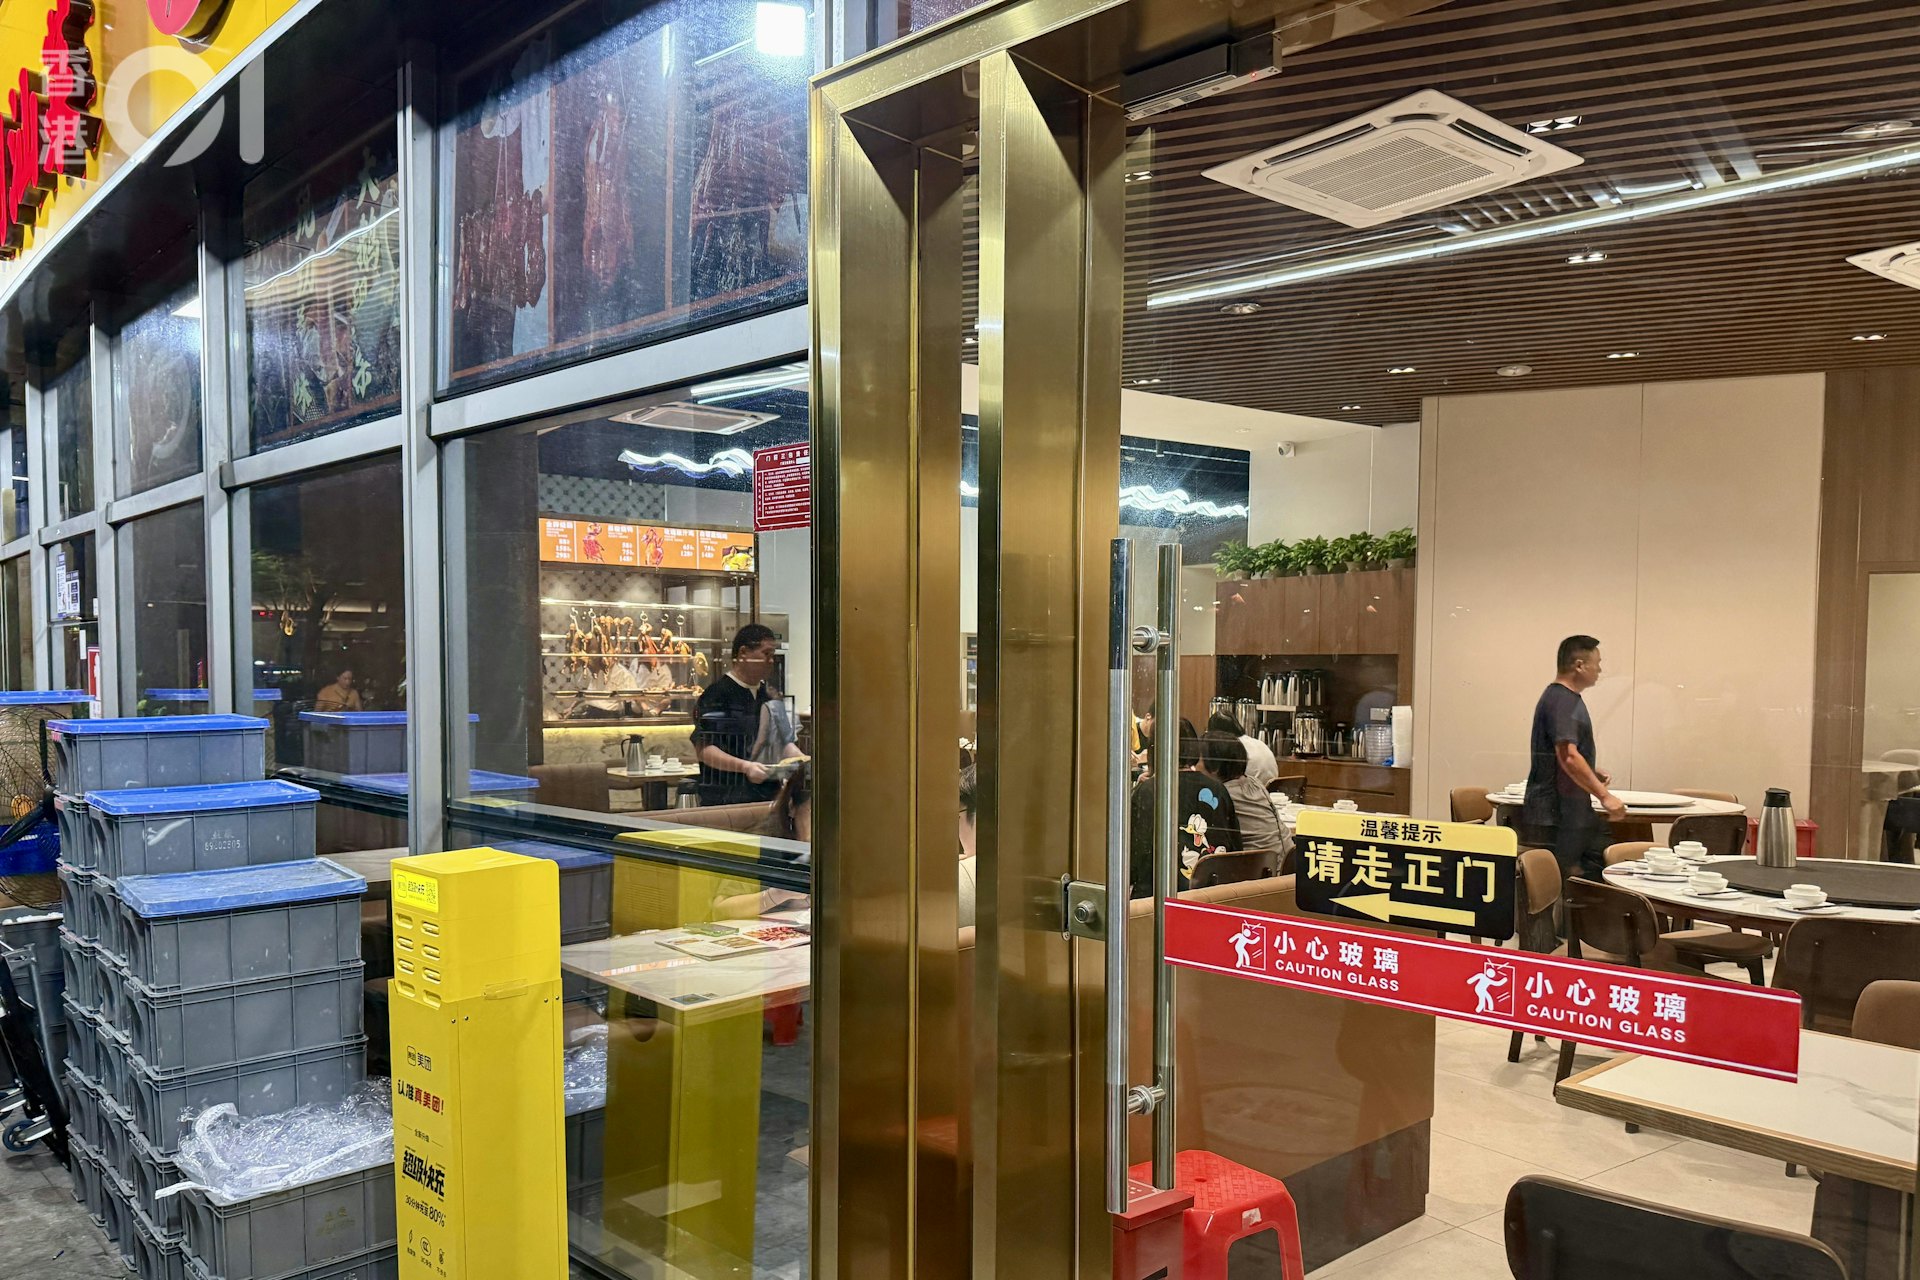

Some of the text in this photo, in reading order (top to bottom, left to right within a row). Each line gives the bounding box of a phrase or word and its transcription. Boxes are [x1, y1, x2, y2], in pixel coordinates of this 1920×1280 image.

[1361, 819, 1442, 843] 温馨提示
[1304, 841, 1496, 903] 请走正门
[1273, 930, 1399, 975] 小心玻璃
[1275, 959, 1399, 992] CAUTION GLASS
[1525, 971, 1687, 1023] 小心玻璃
[1526, 1004, 1686, 1043] CAUTION GLASS
[417, 1052, 432, 1072] 美团
[402, 1150, 445, 1198] 超级快充
